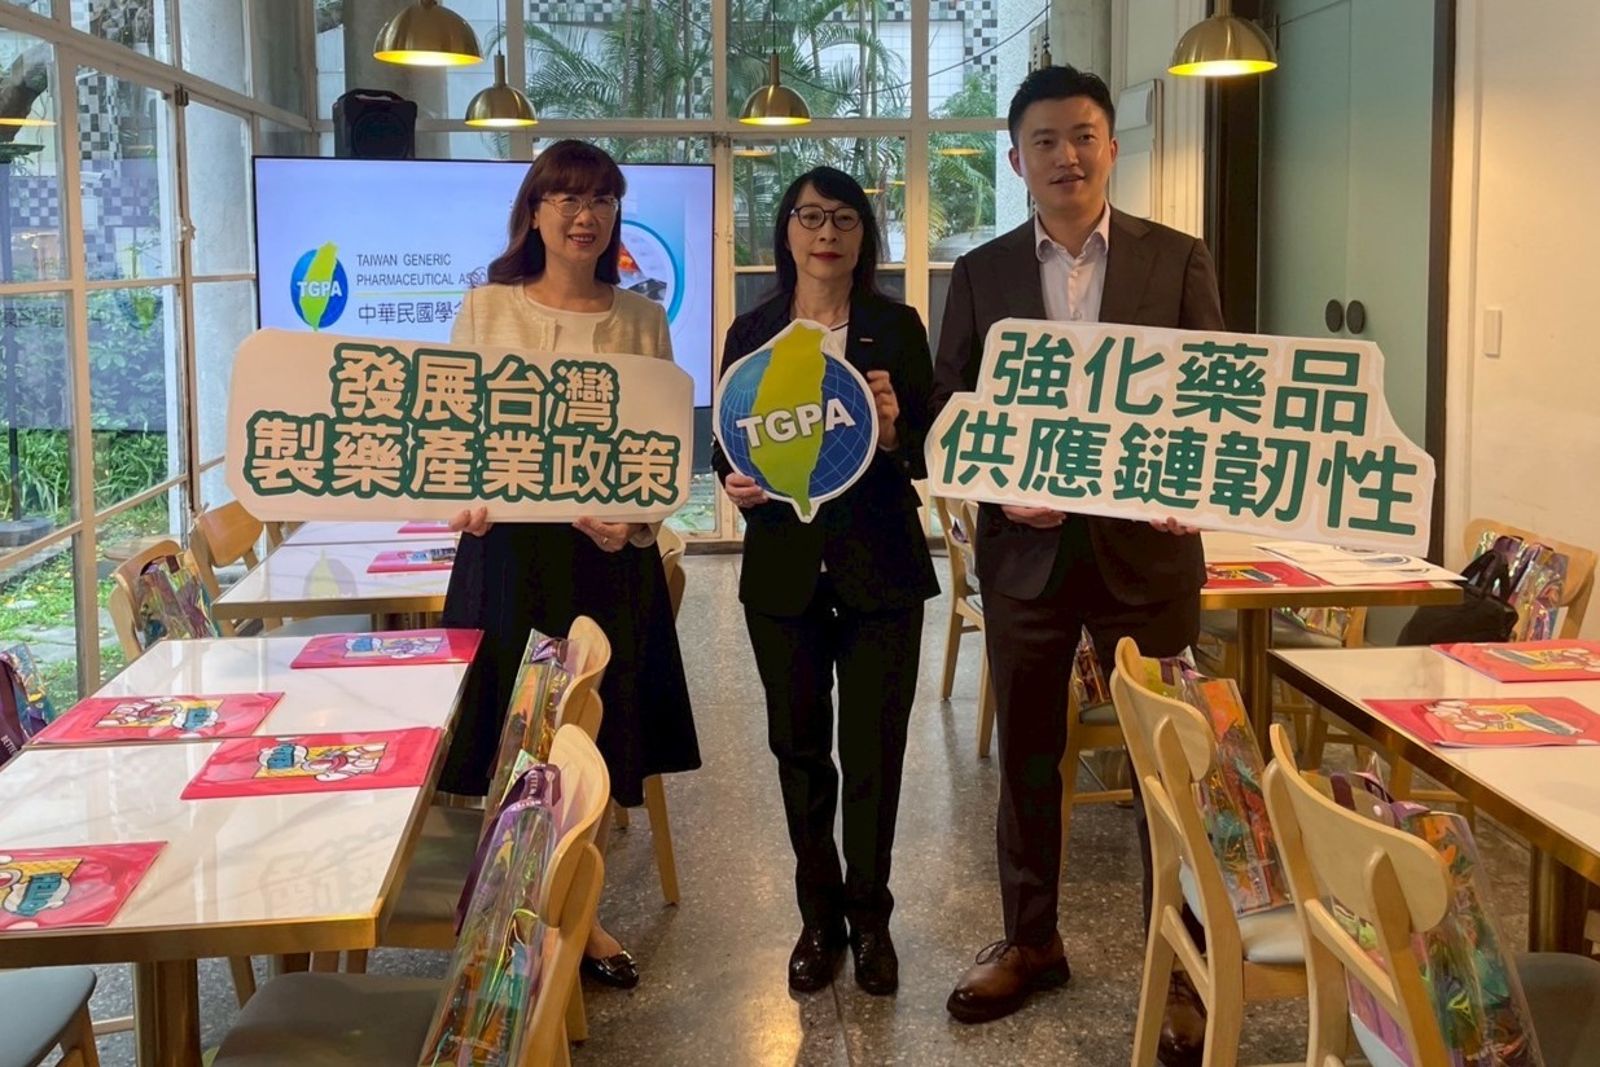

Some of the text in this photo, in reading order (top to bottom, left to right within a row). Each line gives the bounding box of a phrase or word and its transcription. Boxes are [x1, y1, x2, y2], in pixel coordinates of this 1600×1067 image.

[297, 281, 342, 297] TGPA
[356, 273, 454, 286] PHARMACEUTICAL
[357, 253, 451, 266] TAIWAN GENERIC
[332, 343, 620, 437] 發展台灣
[992, 332, 1369, 436] 強化藥品
[246, 411, 680, 507] 製藥產業政策
[736, 398, 856, 448] TGPA
[940, 409, 1417, 536] 供應鏈韌性
